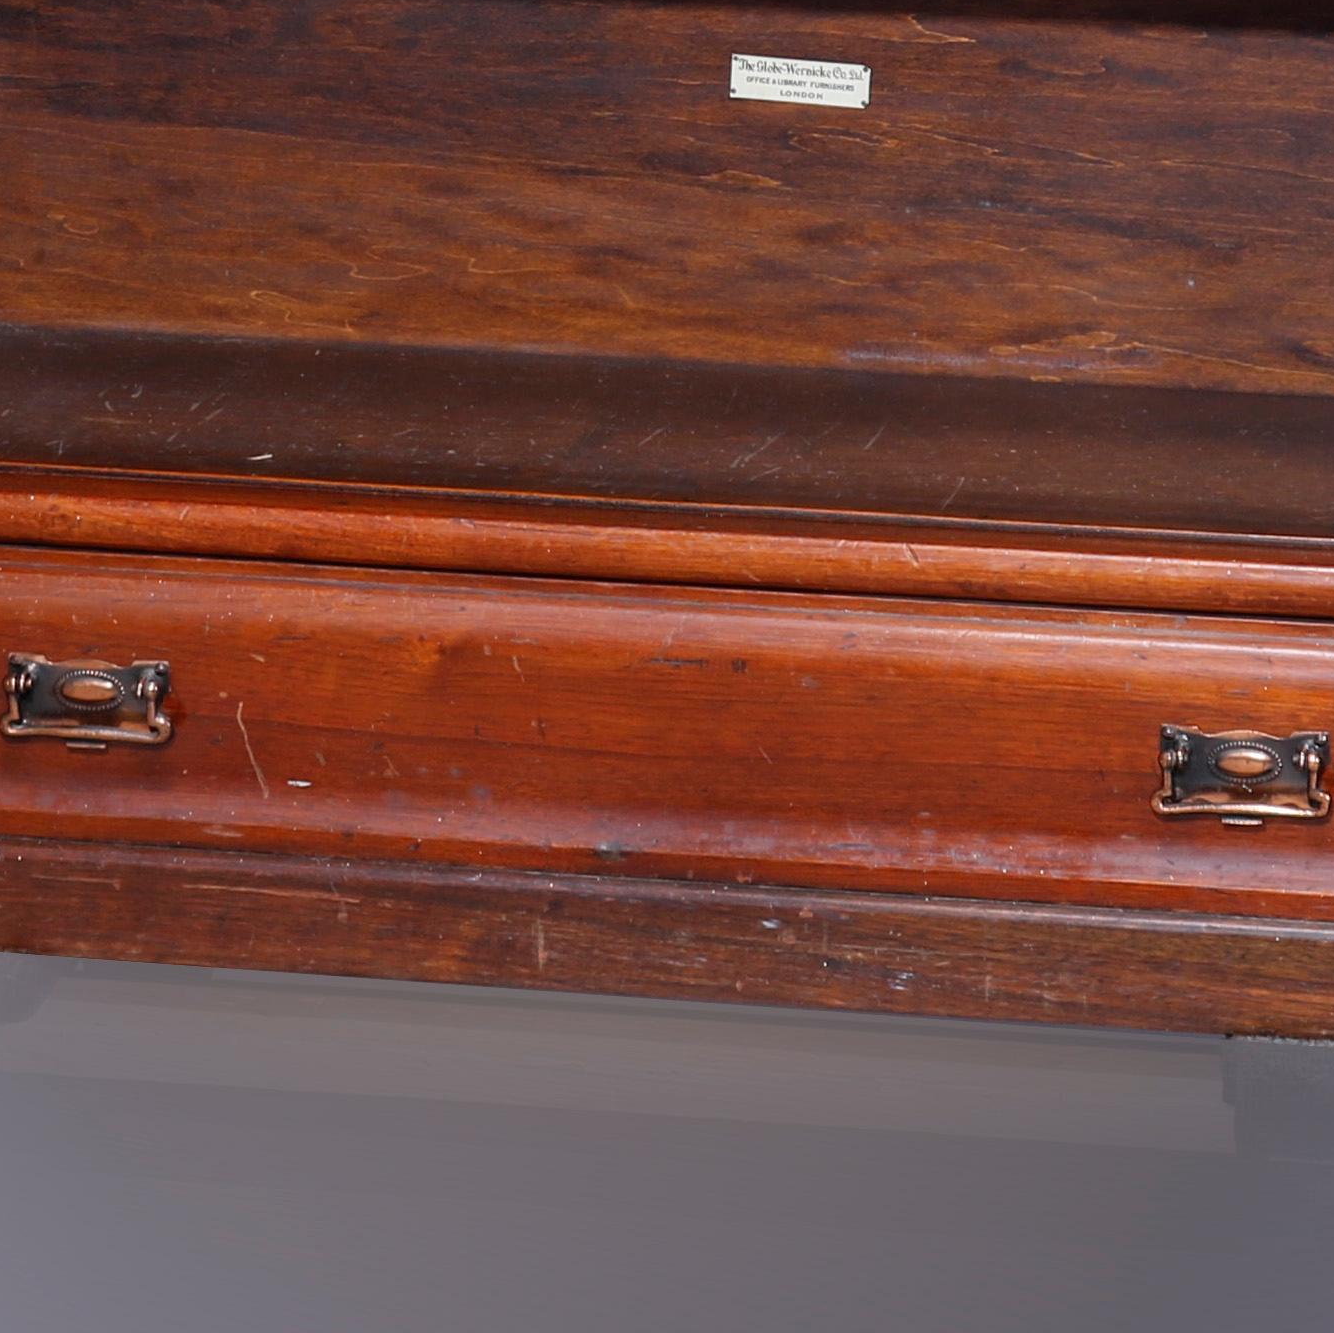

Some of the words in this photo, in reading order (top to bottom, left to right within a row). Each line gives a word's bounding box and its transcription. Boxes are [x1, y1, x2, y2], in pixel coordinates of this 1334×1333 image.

[739, 58, 755, 72] The
[746, 76, 770, 85] OFFICE
[777, 79, 808, 88] LIBRARY
[779, 89, 824, 100] LONDON
